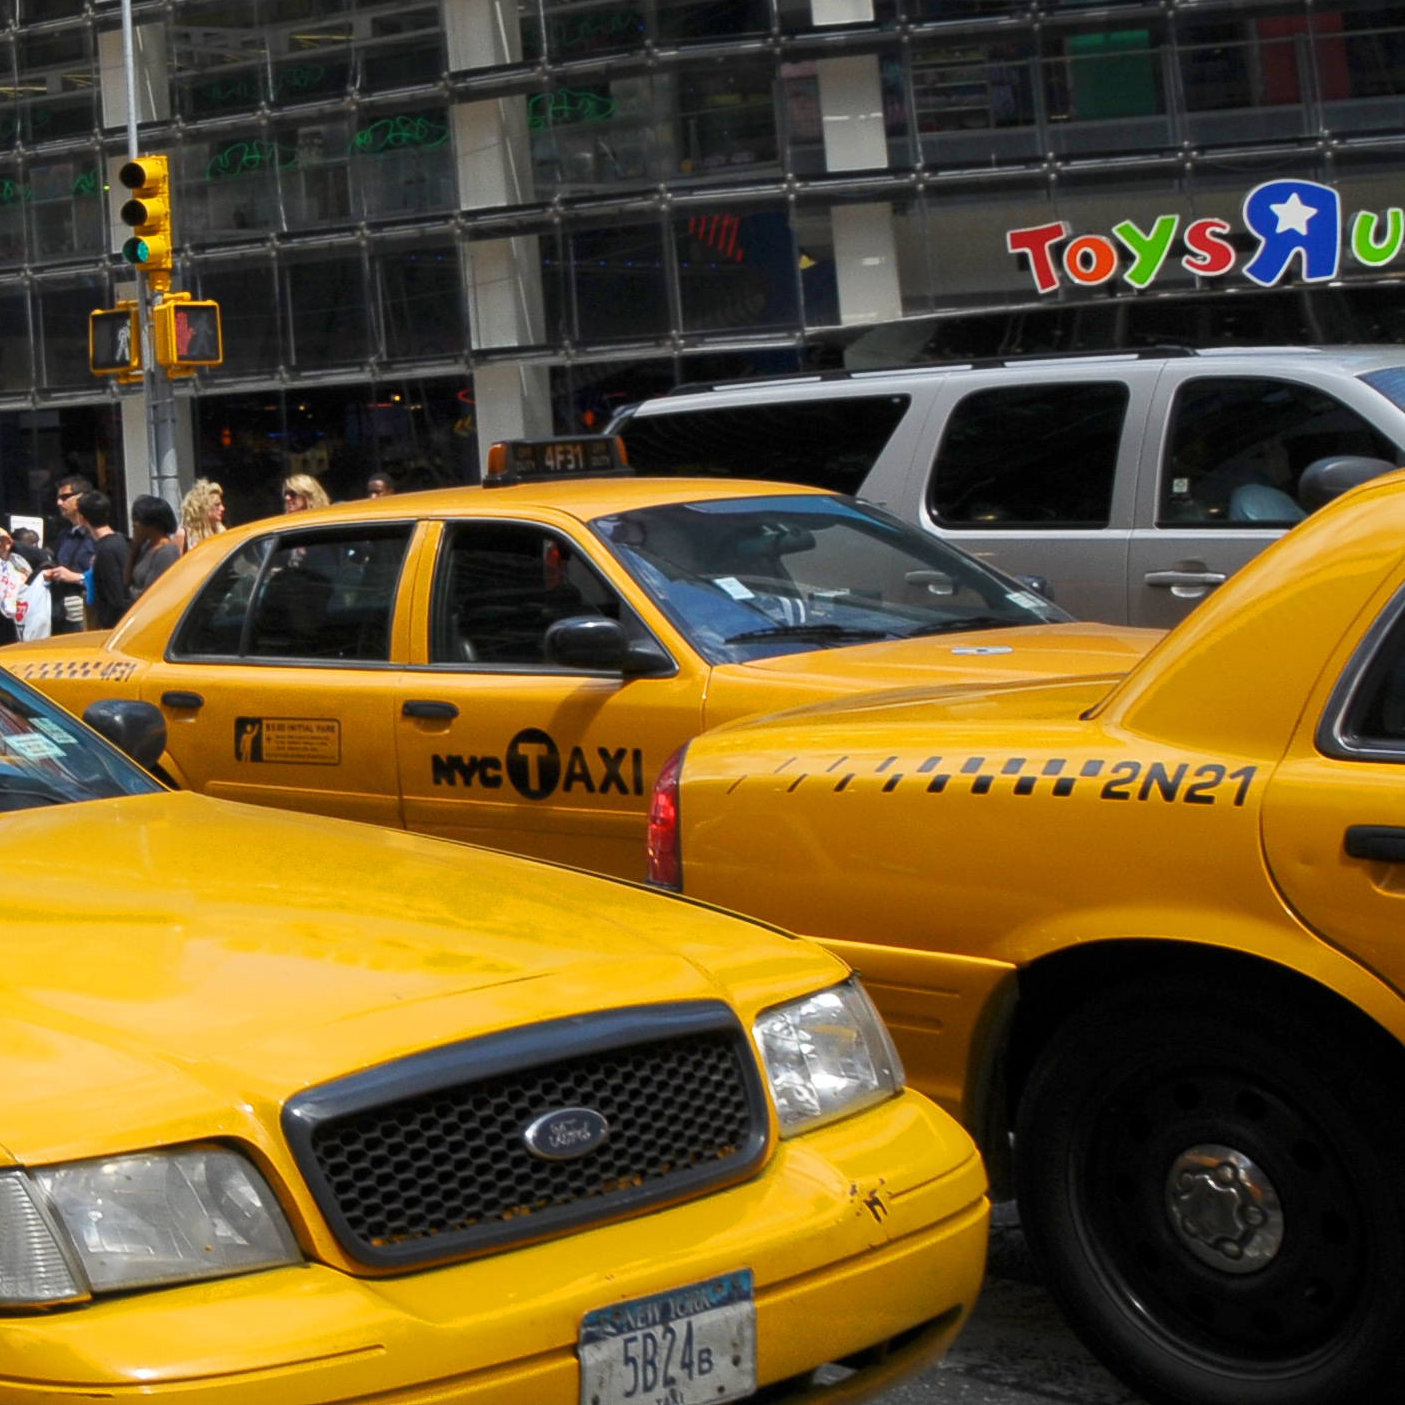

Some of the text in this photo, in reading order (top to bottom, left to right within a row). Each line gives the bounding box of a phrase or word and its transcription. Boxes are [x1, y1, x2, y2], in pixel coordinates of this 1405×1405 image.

[1006, 213, 1238, 294] TOYS
[431, 734, 644, 799] NYC TAXI
[1100, 760, 1258, 807] 2N21
